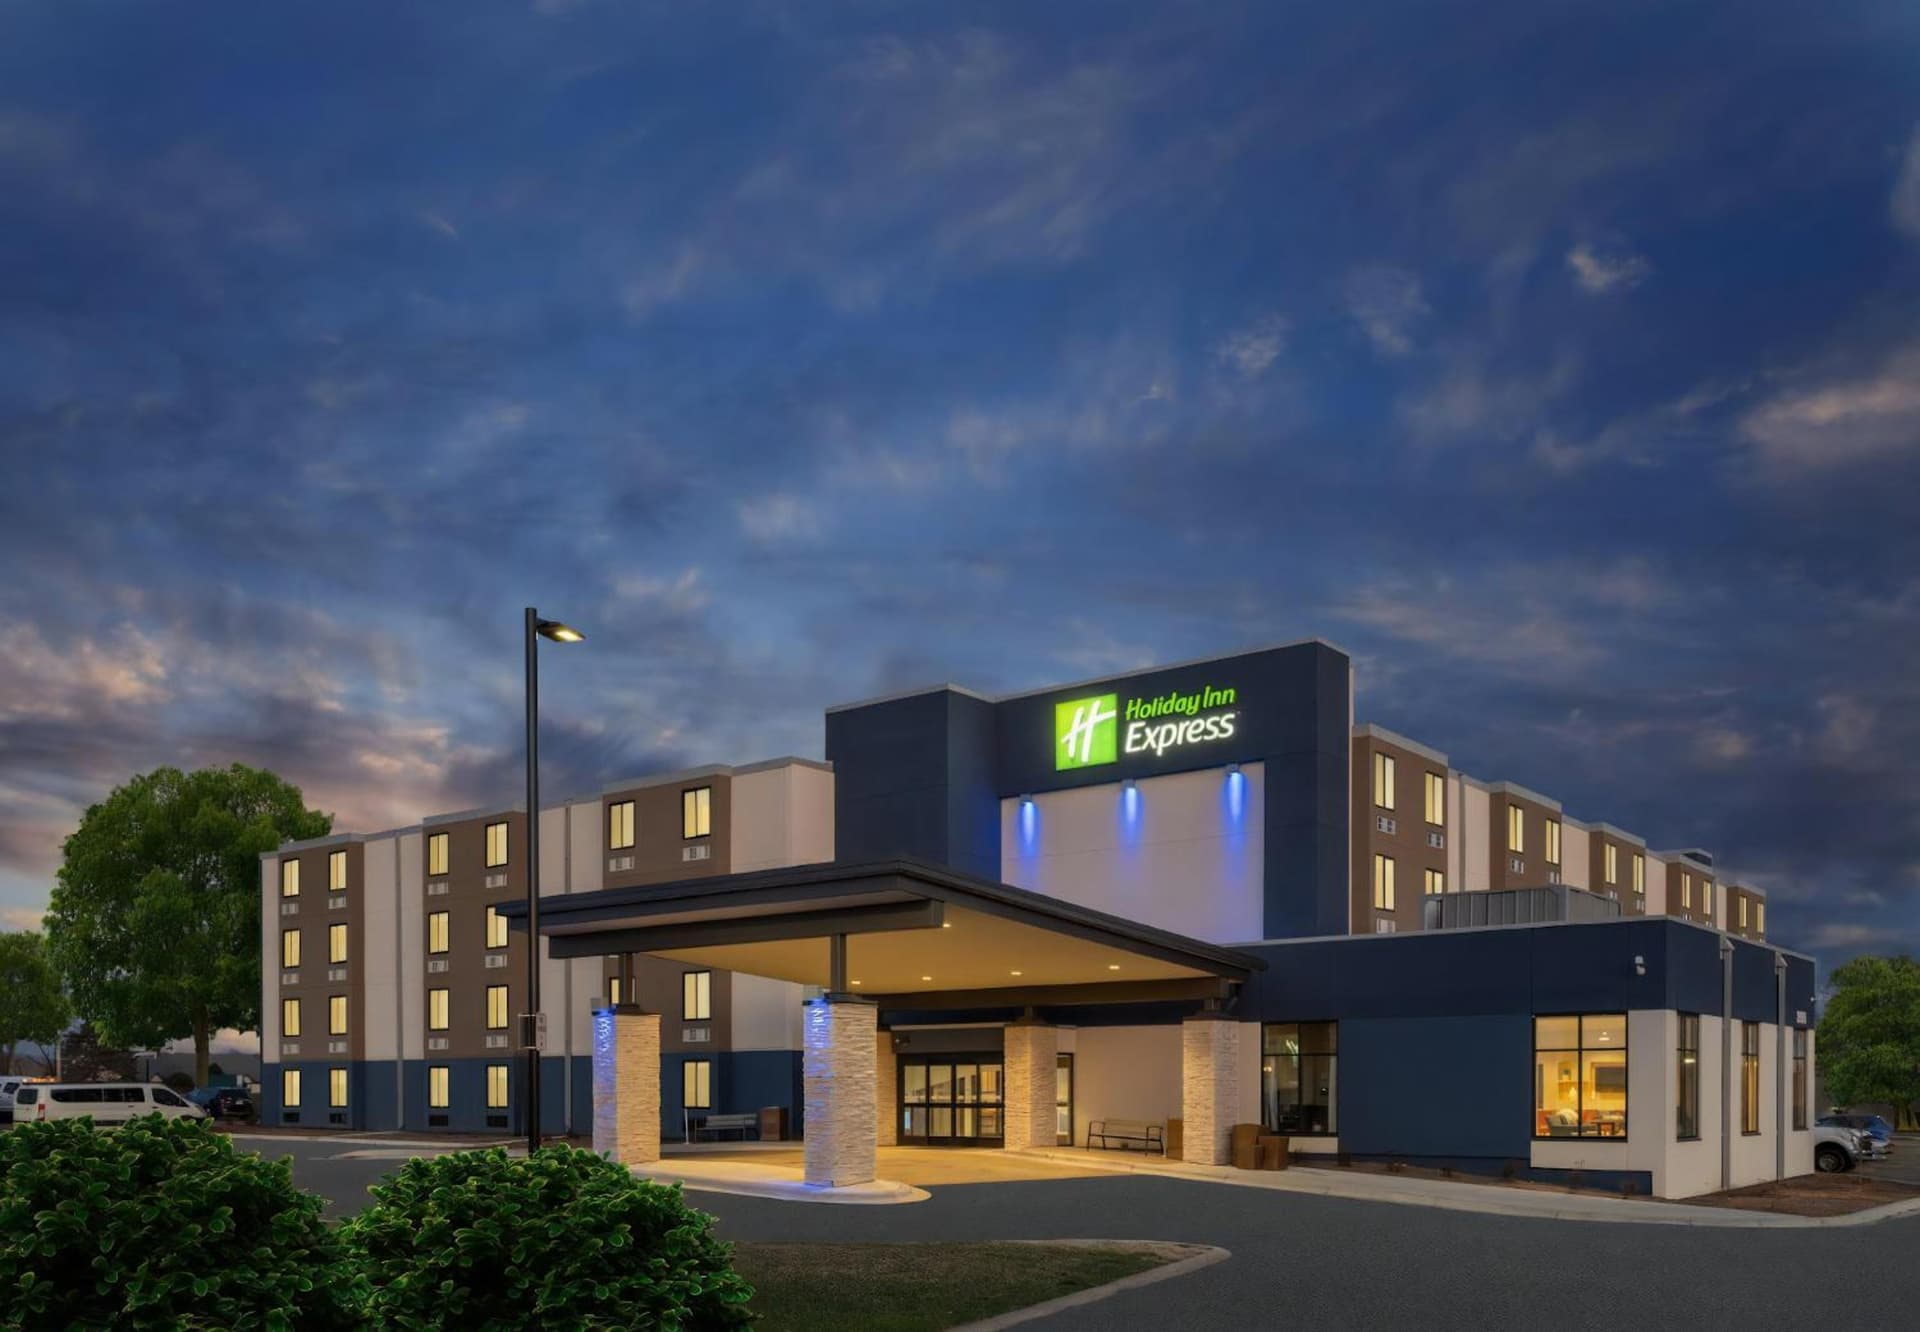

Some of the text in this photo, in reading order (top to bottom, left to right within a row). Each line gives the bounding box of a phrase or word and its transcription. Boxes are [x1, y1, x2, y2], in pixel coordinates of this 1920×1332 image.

[1126, 686, 1235, 720] Holiday Inn
[1125, 713, 1235, 757] Express
